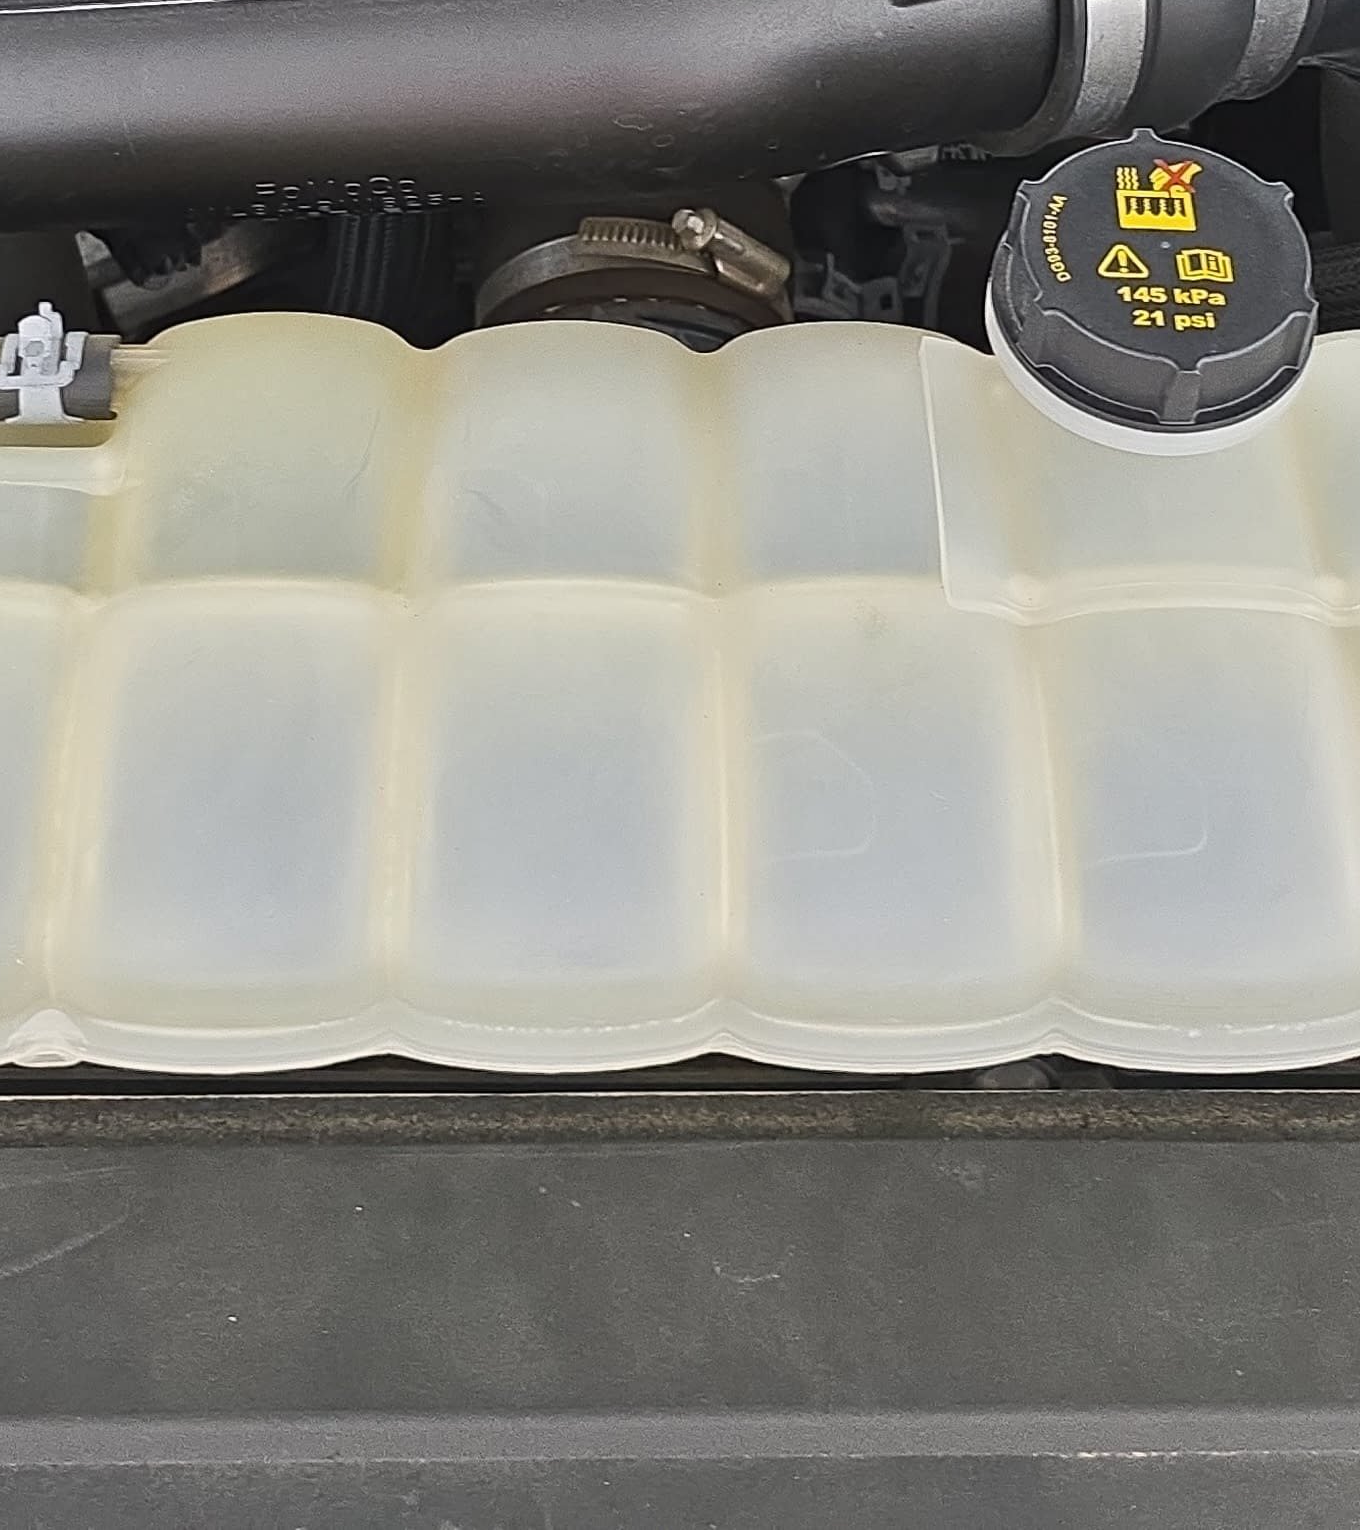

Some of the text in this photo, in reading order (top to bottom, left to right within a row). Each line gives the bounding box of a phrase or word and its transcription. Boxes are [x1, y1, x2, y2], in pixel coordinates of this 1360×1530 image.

[1116, 286, 1227, 306] 145 kPa
[1133, 309, 1216, 331] 21 psi
